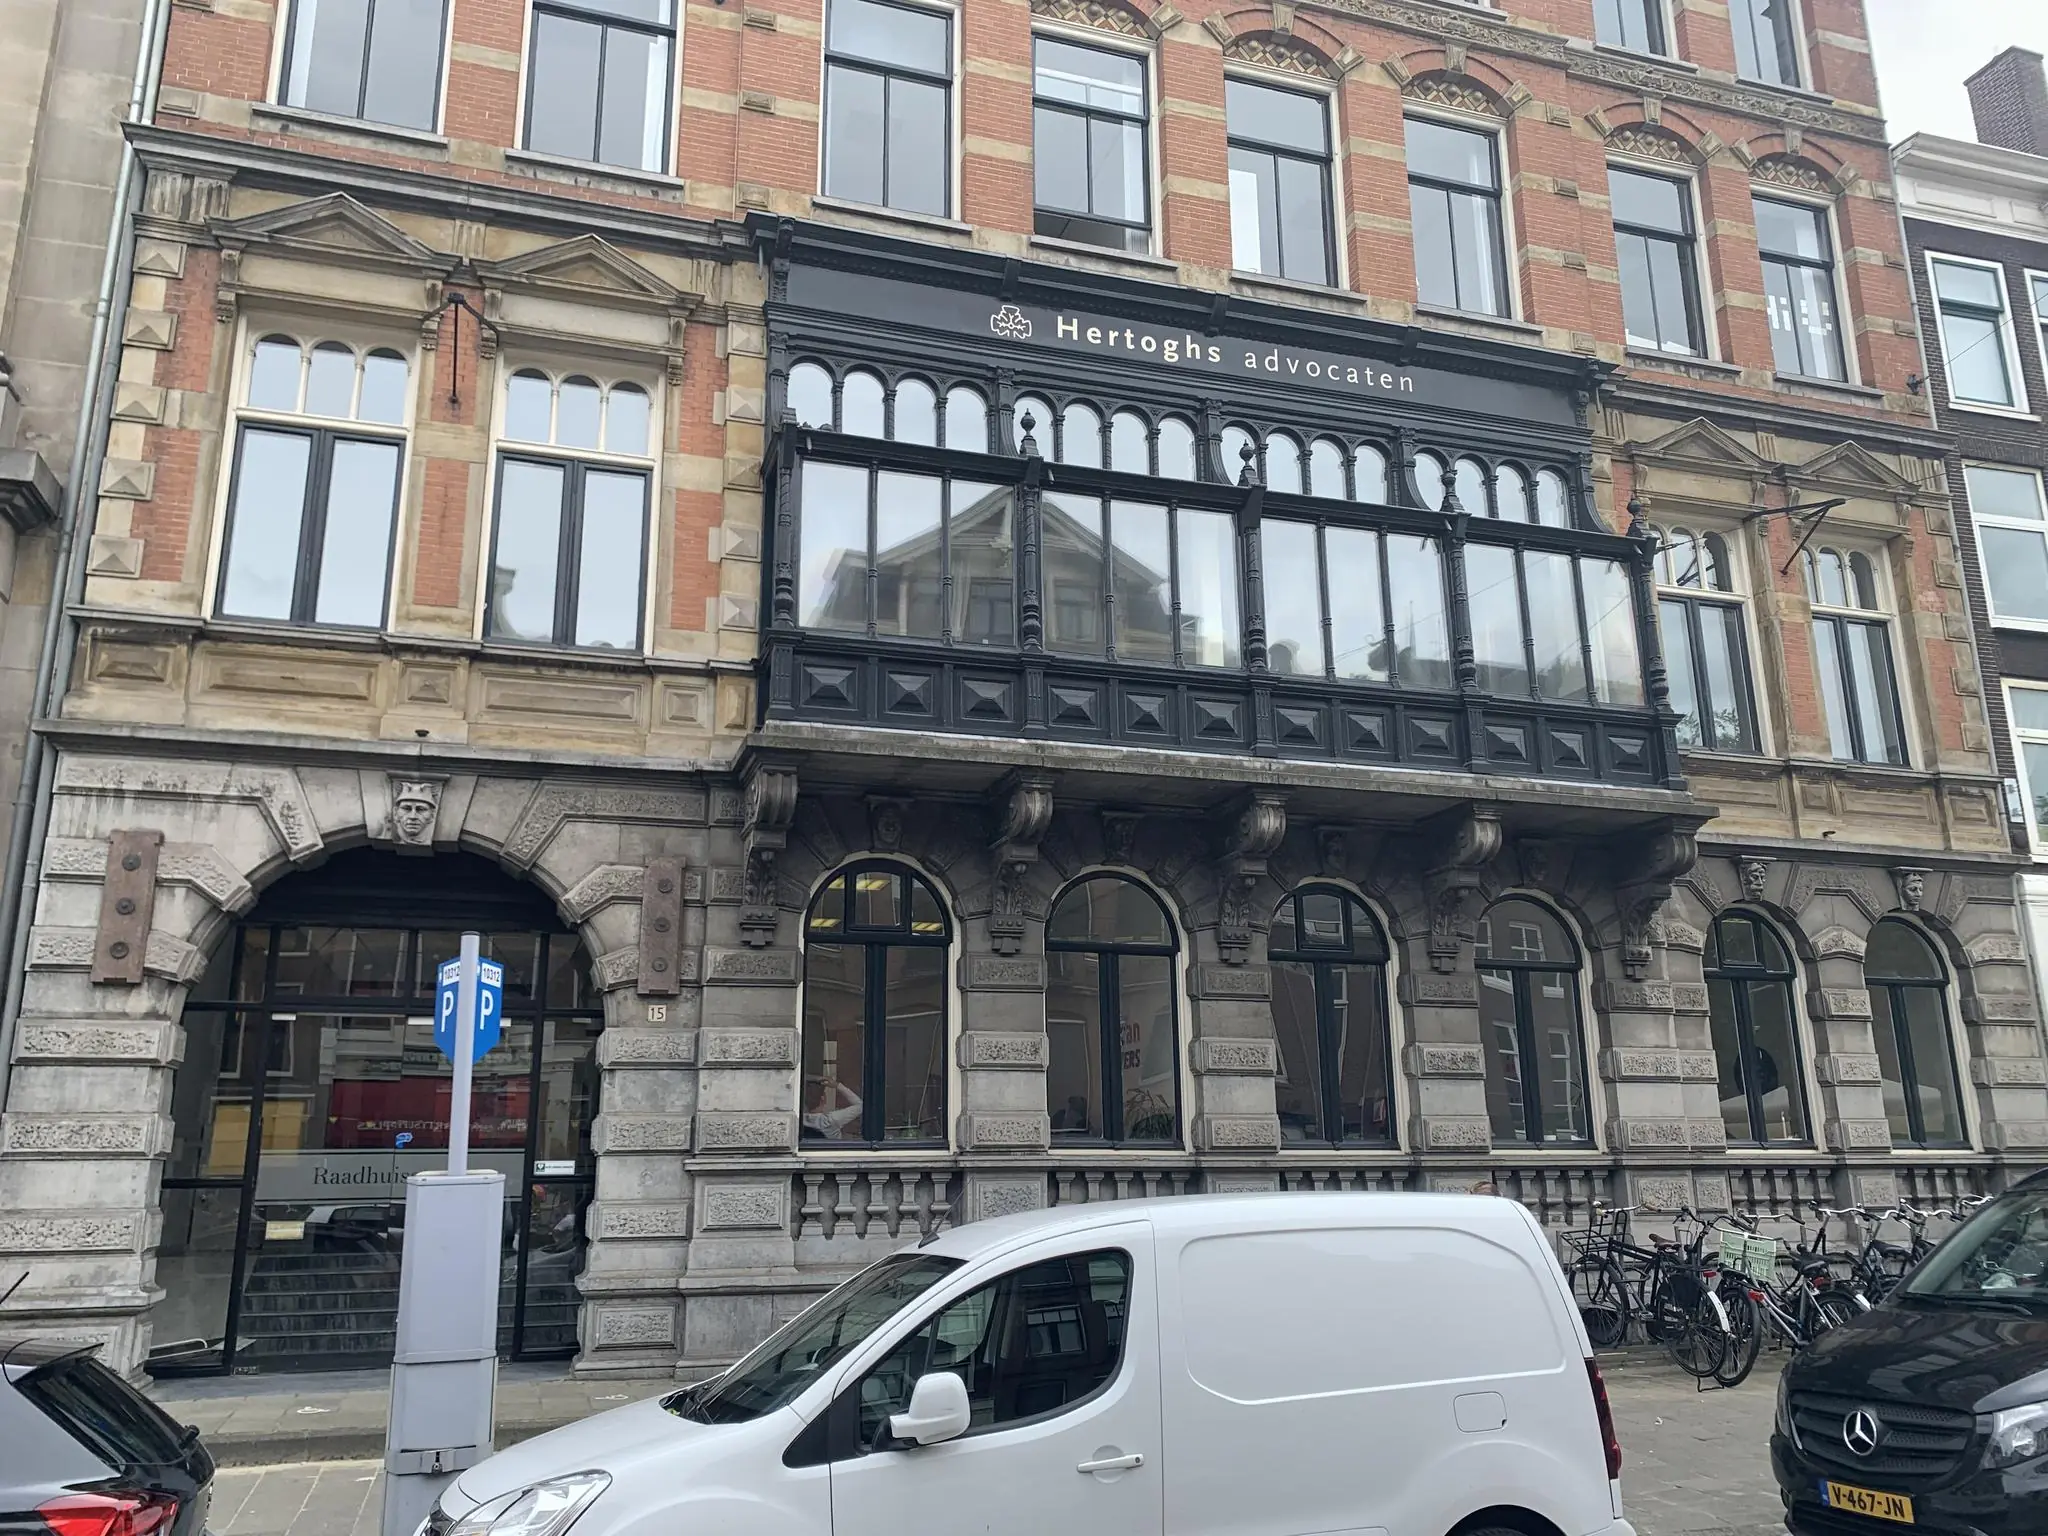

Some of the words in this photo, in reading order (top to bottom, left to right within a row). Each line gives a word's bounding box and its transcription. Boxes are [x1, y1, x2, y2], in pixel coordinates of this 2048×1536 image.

[1056, 315, 1221, 363] Hertoghs
[1244, 349, 1414, 393] advocaten
[483, 966, 500, 983] 10312
[441, 990, 455, 1033] P
[480, 989, 494, 1031] P
[650, 1007, 664, 1020] 15
[313, 1165, 418, 1185] Raadhuis
[1831, 1485, 1906, 1519] V-467-JN
